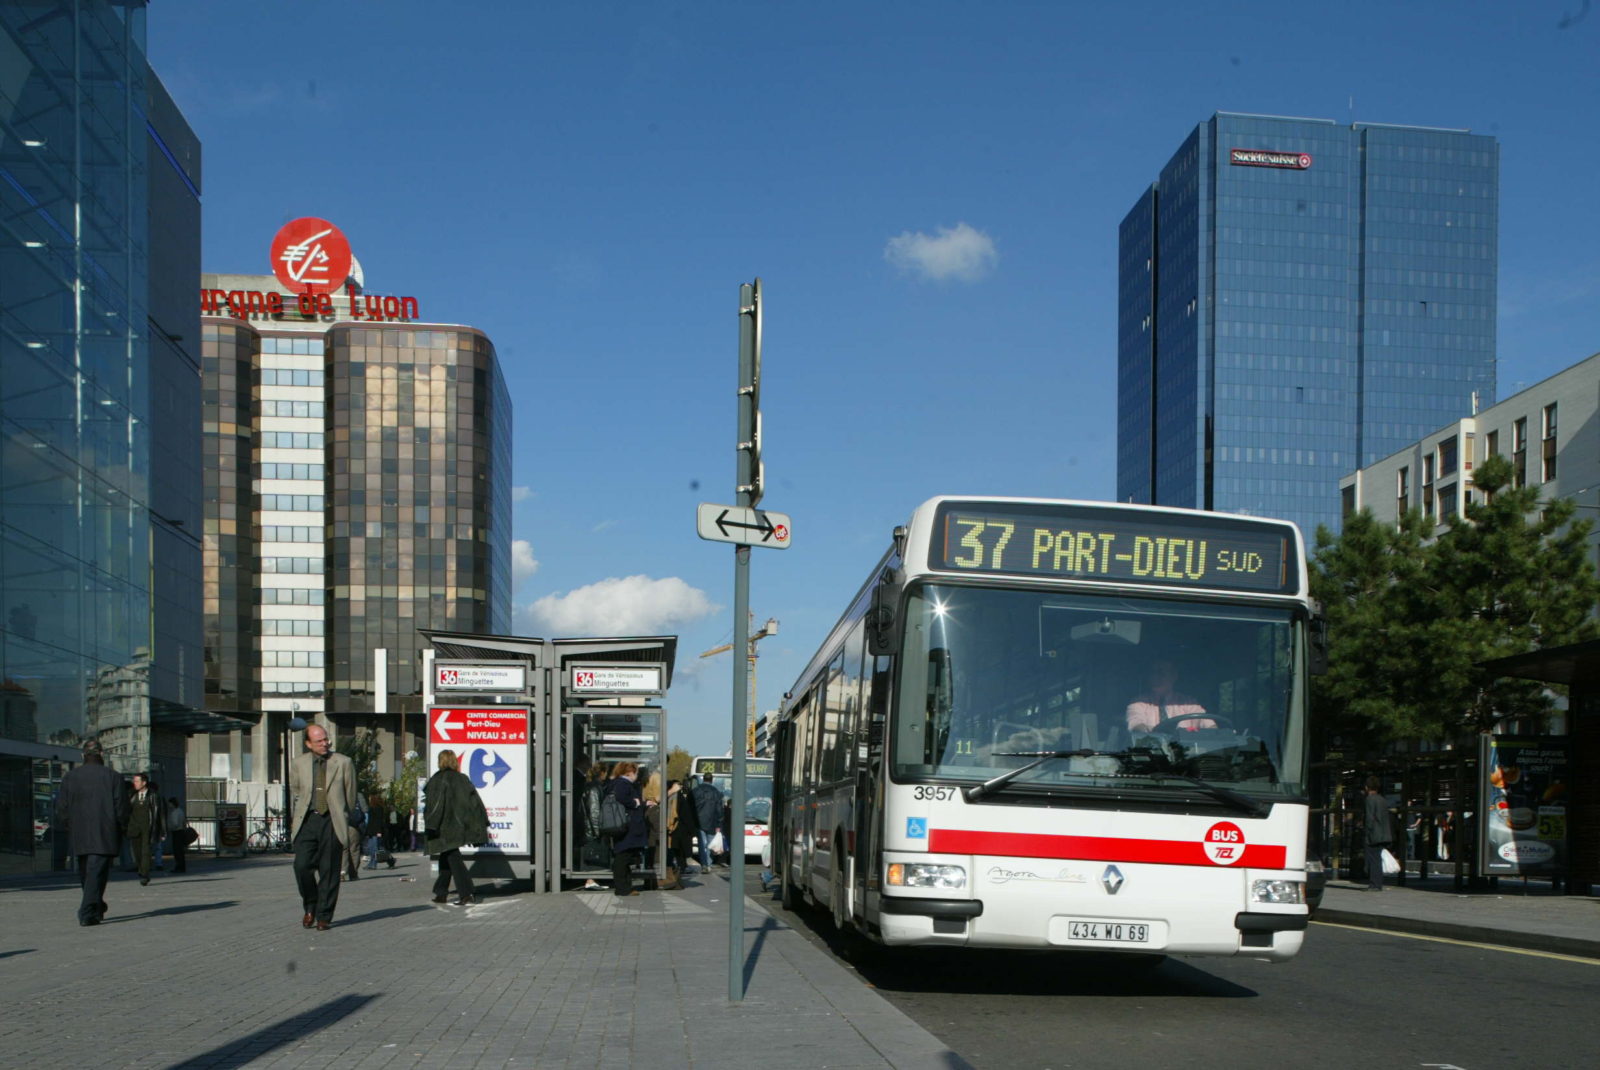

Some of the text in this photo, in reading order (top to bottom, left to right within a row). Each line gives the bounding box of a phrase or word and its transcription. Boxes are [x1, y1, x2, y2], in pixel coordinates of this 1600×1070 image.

[298, 283, 333, 316] de
[348, 284, 420, 321] Lyon
[955, 517, 1263, 580] 37 PART-DIEU SUD
[441, 671, 457, 685] 36
[458, 677, 494, 686] Minguettes
[577, 672, 593, 687] 36
[595, 679, 629, 688] Minguettes
[466, 720, 501, 728] Part-Dieu
[466, 731, 525, 740] NIVEAU 3 et 4
[956, 740, 973, 754] 11
[702, 761, 715, 773] 28
[913, 786, 956, 801] 3957
[490, 821, 513, 830] our
[1212, 829, 1239, 842] BUS
[1215, 847, 1235, 859] TCL
[1072, 923, 1145, 941] 434 WQ 69
